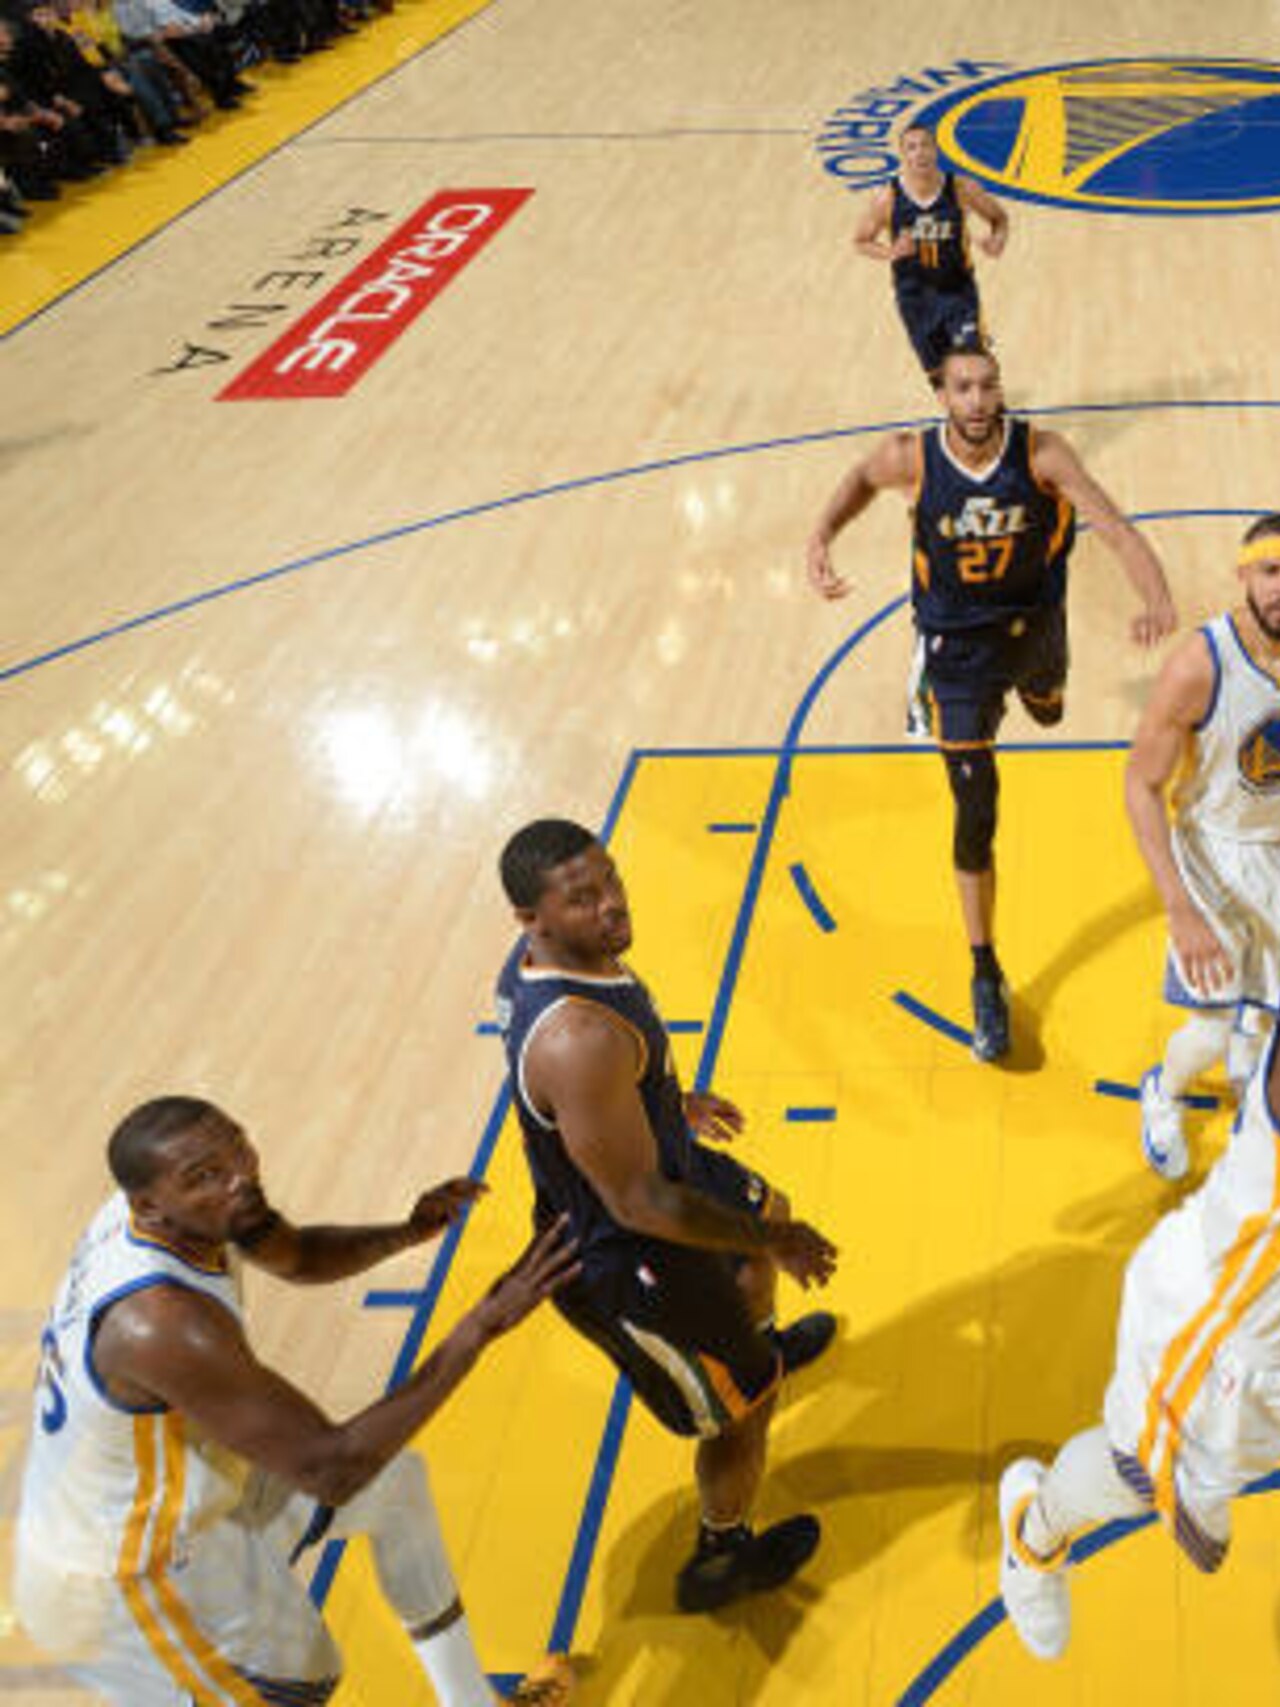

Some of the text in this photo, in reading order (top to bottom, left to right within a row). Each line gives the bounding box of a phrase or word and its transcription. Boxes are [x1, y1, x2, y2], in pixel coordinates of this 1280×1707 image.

[814, 59, 1016, 192] WARRIO
[147, 206, 391, 377] ARENA
[273, 203, 494, 376] ORACLE
[957, 536, 1013, 582] 27
